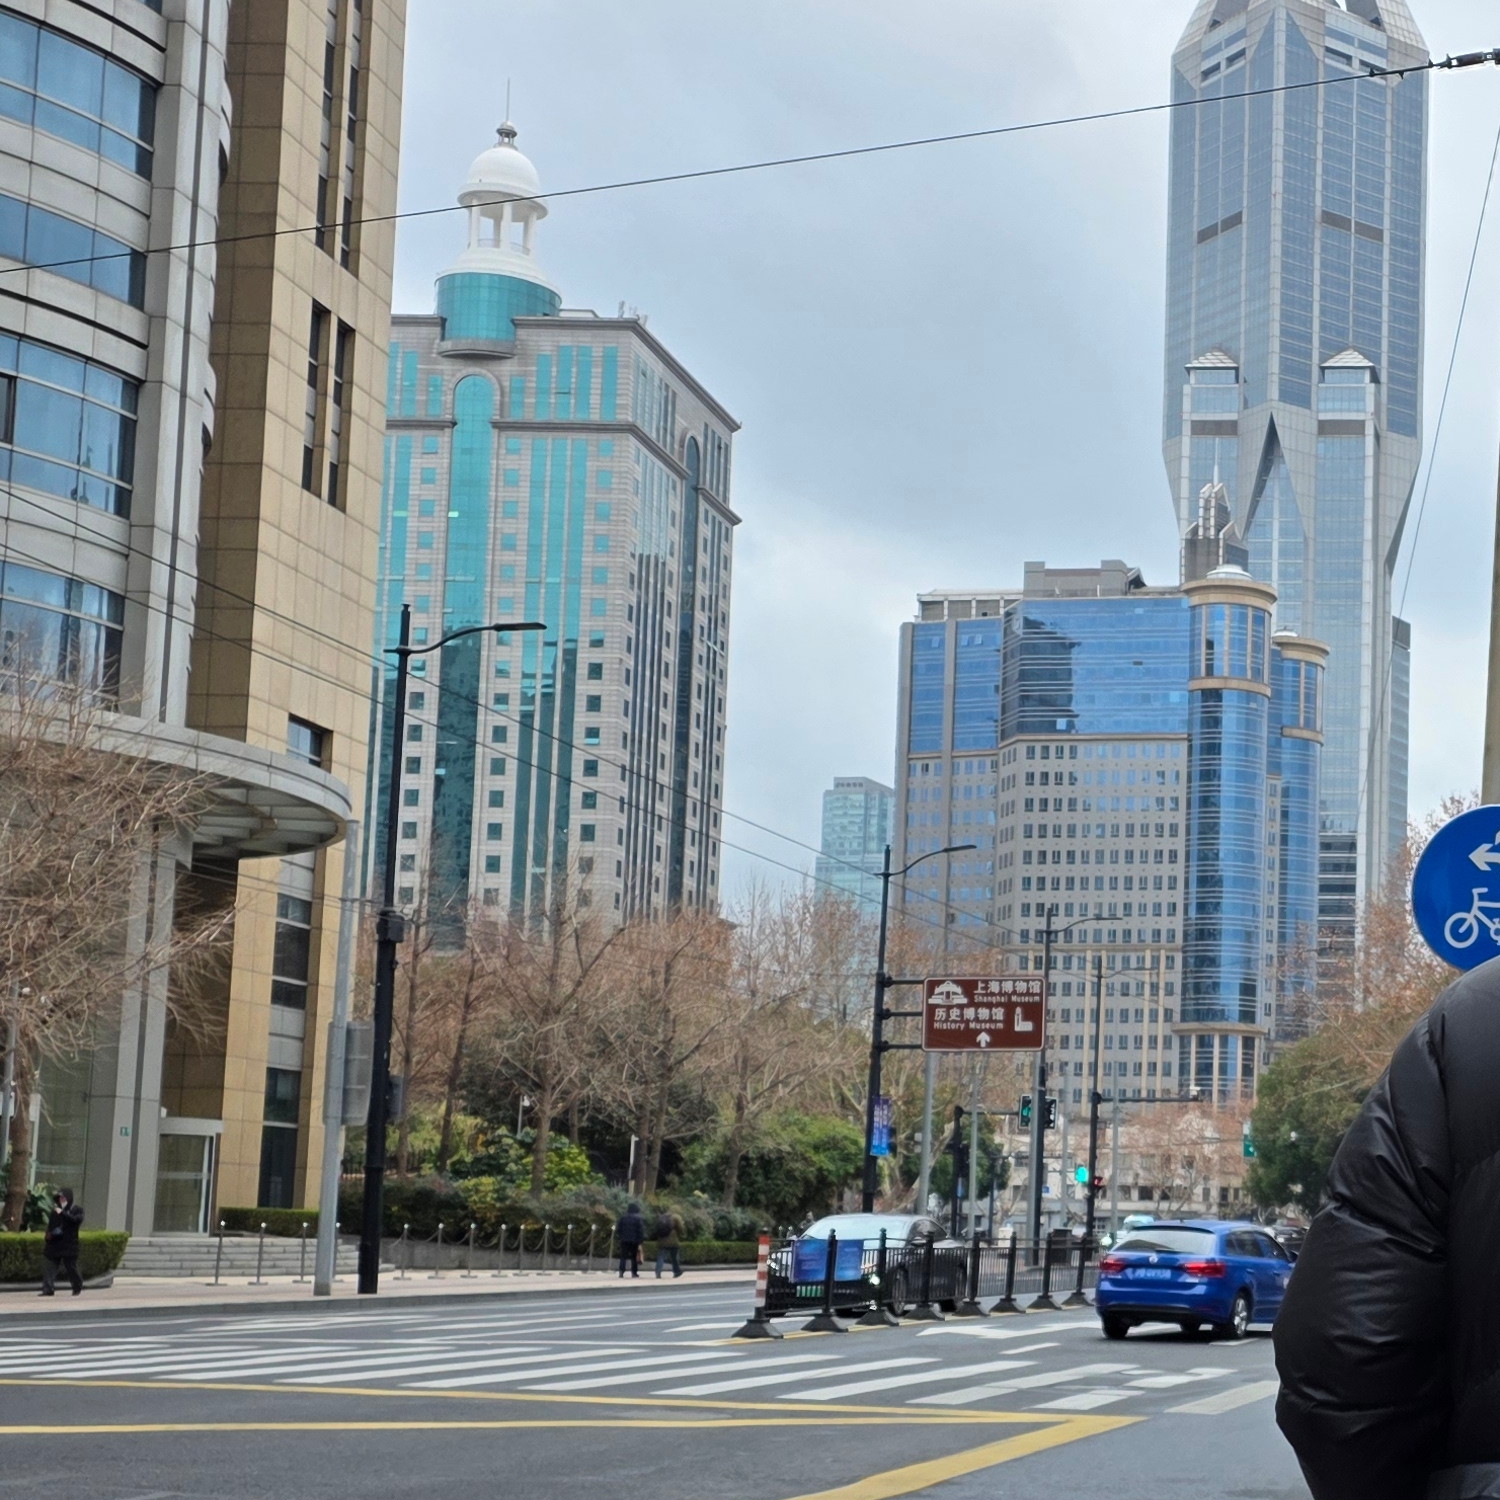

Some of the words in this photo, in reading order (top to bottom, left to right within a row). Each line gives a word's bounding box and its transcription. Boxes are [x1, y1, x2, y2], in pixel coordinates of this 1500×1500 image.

[974, 980, 1041, 993] 上海博物馆
[974, 995, 1007, 1004] Shanghai
[934, 1007, 1005, 1021] 历史博物馆
[934, 1022, 965, 1031] History
[969, 1022, 1004, 1030] Museum
